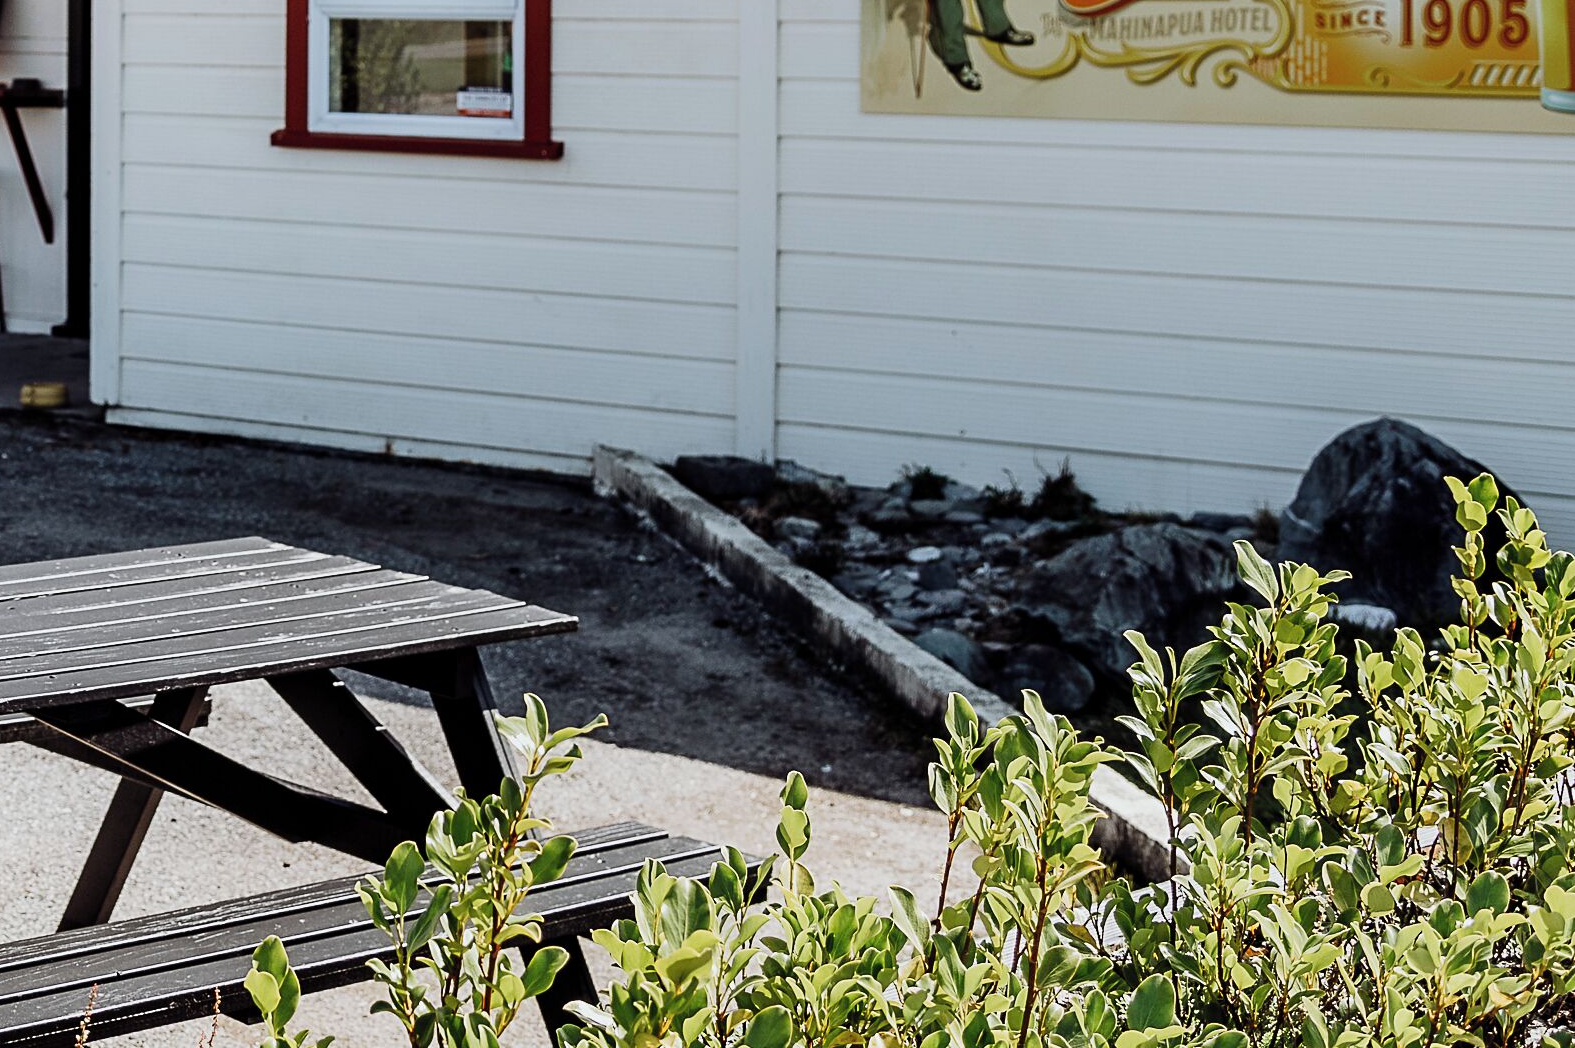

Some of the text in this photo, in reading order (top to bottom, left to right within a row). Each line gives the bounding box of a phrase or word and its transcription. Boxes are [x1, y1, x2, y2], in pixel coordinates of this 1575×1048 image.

[1088, 12, 1205, 40] MAHINAPUA
[1209, 7, 1273, 34] HOTEL
[1314, 9, 1387, 30] SINCE
